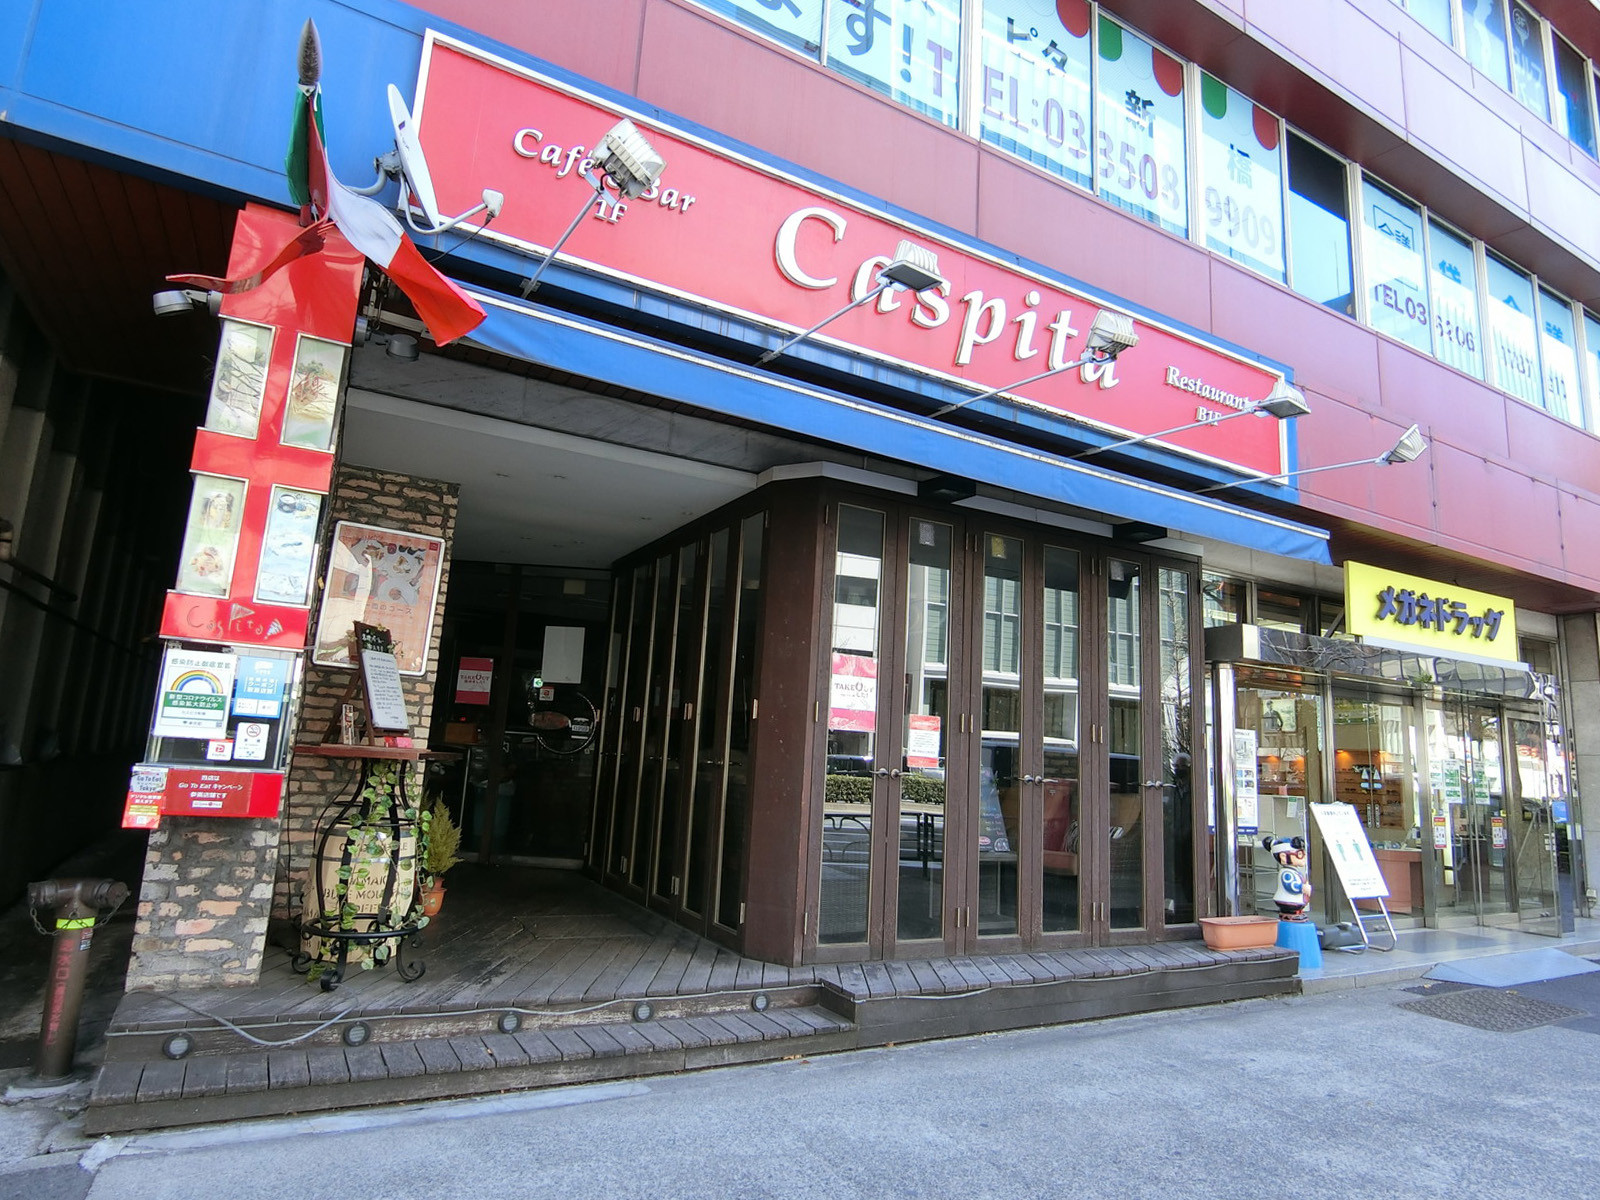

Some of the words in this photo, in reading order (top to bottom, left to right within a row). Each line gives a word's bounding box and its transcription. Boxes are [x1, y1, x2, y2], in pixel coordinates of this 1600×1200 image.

[594, 198, 628, 225] 1F
[775, 206, 1120, 389] Caspita
[1167, 365, 1252, 411] Restaurant
[1375, 585, 1505, 641] メガネドラッグ
